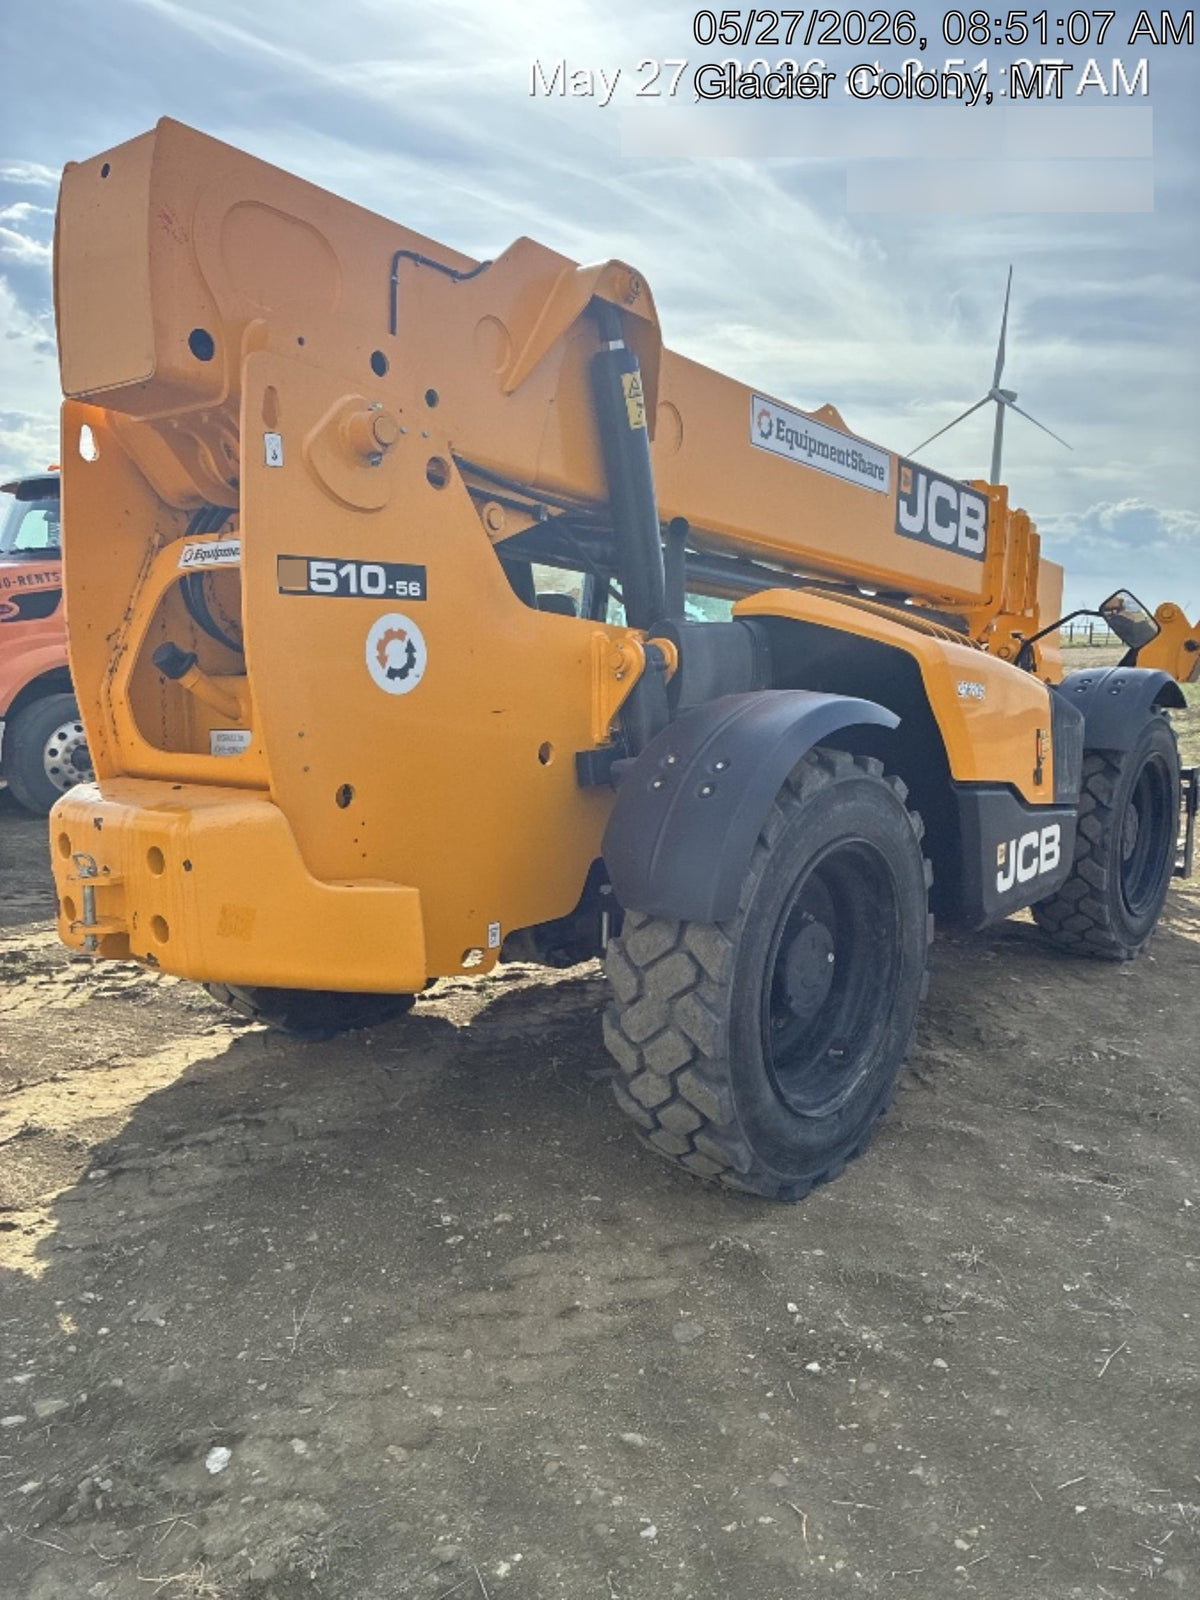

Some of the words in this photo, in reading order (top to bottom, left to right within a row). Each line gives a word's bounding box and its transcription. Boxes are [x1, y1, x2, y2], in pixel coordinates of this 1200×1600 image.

[775, 417, 885, 481] EquipmentShare
[900, 473, 986, 553] JCB
[0, 572, 61, 589] O-RENTS
[997, 824, 1060, 892] JCB
